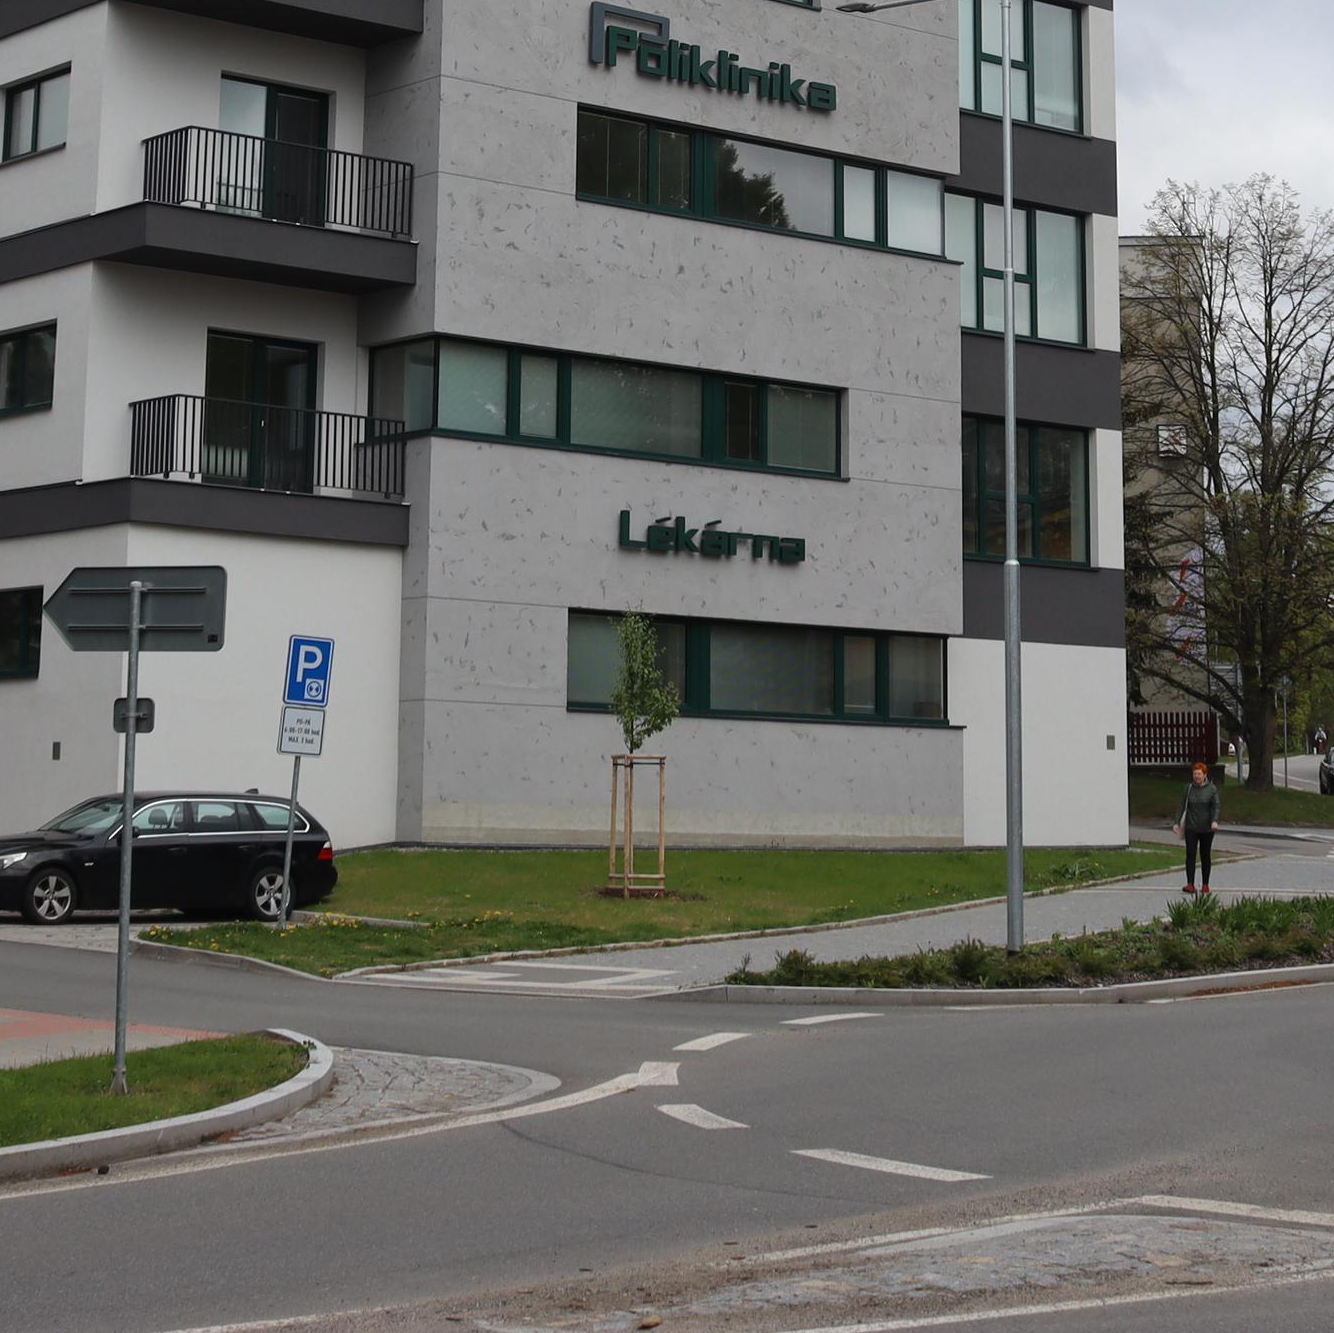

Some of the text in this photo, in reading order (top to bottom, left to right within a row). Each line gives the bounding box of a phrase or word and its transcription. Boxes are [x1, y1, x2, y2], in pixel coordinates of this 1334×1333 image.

[604, 23, 837, 111] Poliklinika
[619, 510, 806, 562] Lékárna
[296, 644, 323, 683] P
